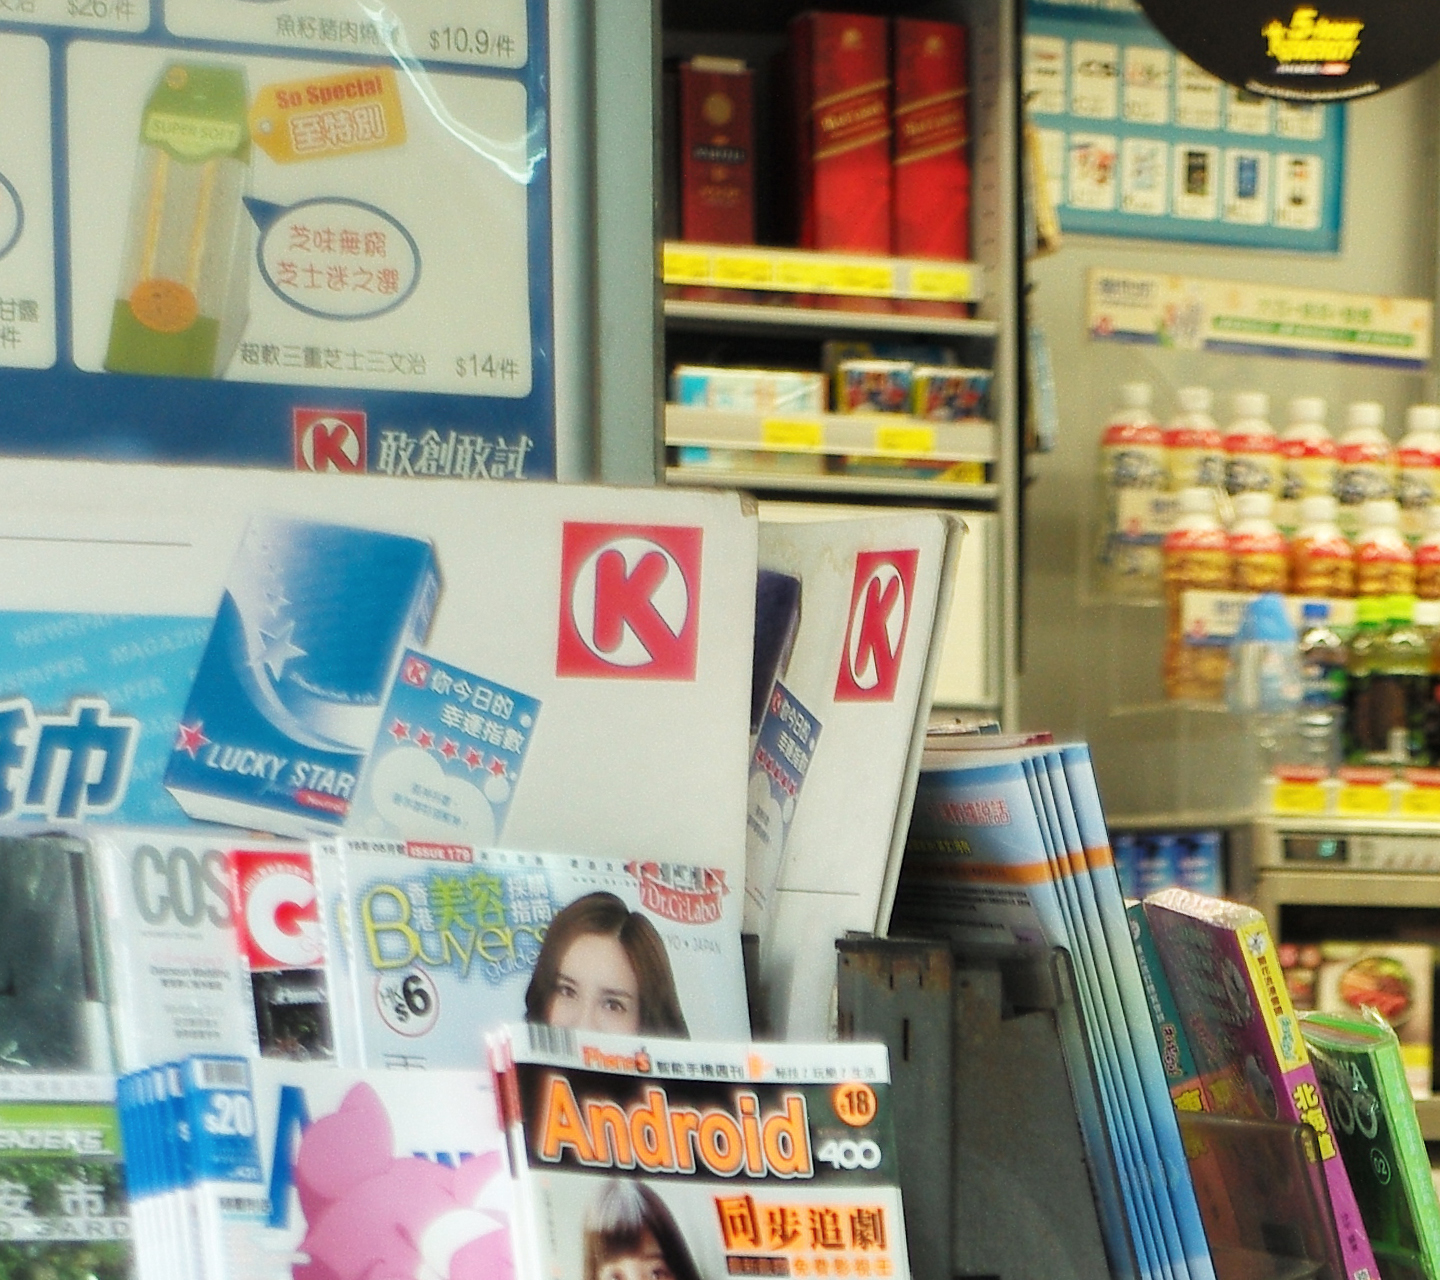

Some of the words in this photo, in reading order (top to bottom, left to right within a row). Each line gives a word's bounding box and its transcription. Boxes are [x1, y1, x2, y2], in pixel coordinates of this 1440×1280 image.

[275, 88, 304, 110] So
[307, 75, 384, 105] Special
[289, 104, 388, 153] 至特別
[206, 743, 286, 783] LUCKY
[290, 759, 358, 799] STAR
[540, 1076, 815, 1180] Android
[817, 1138, 883, 1171] 400
[714, 1193, 888, 1252] 同步追劇
